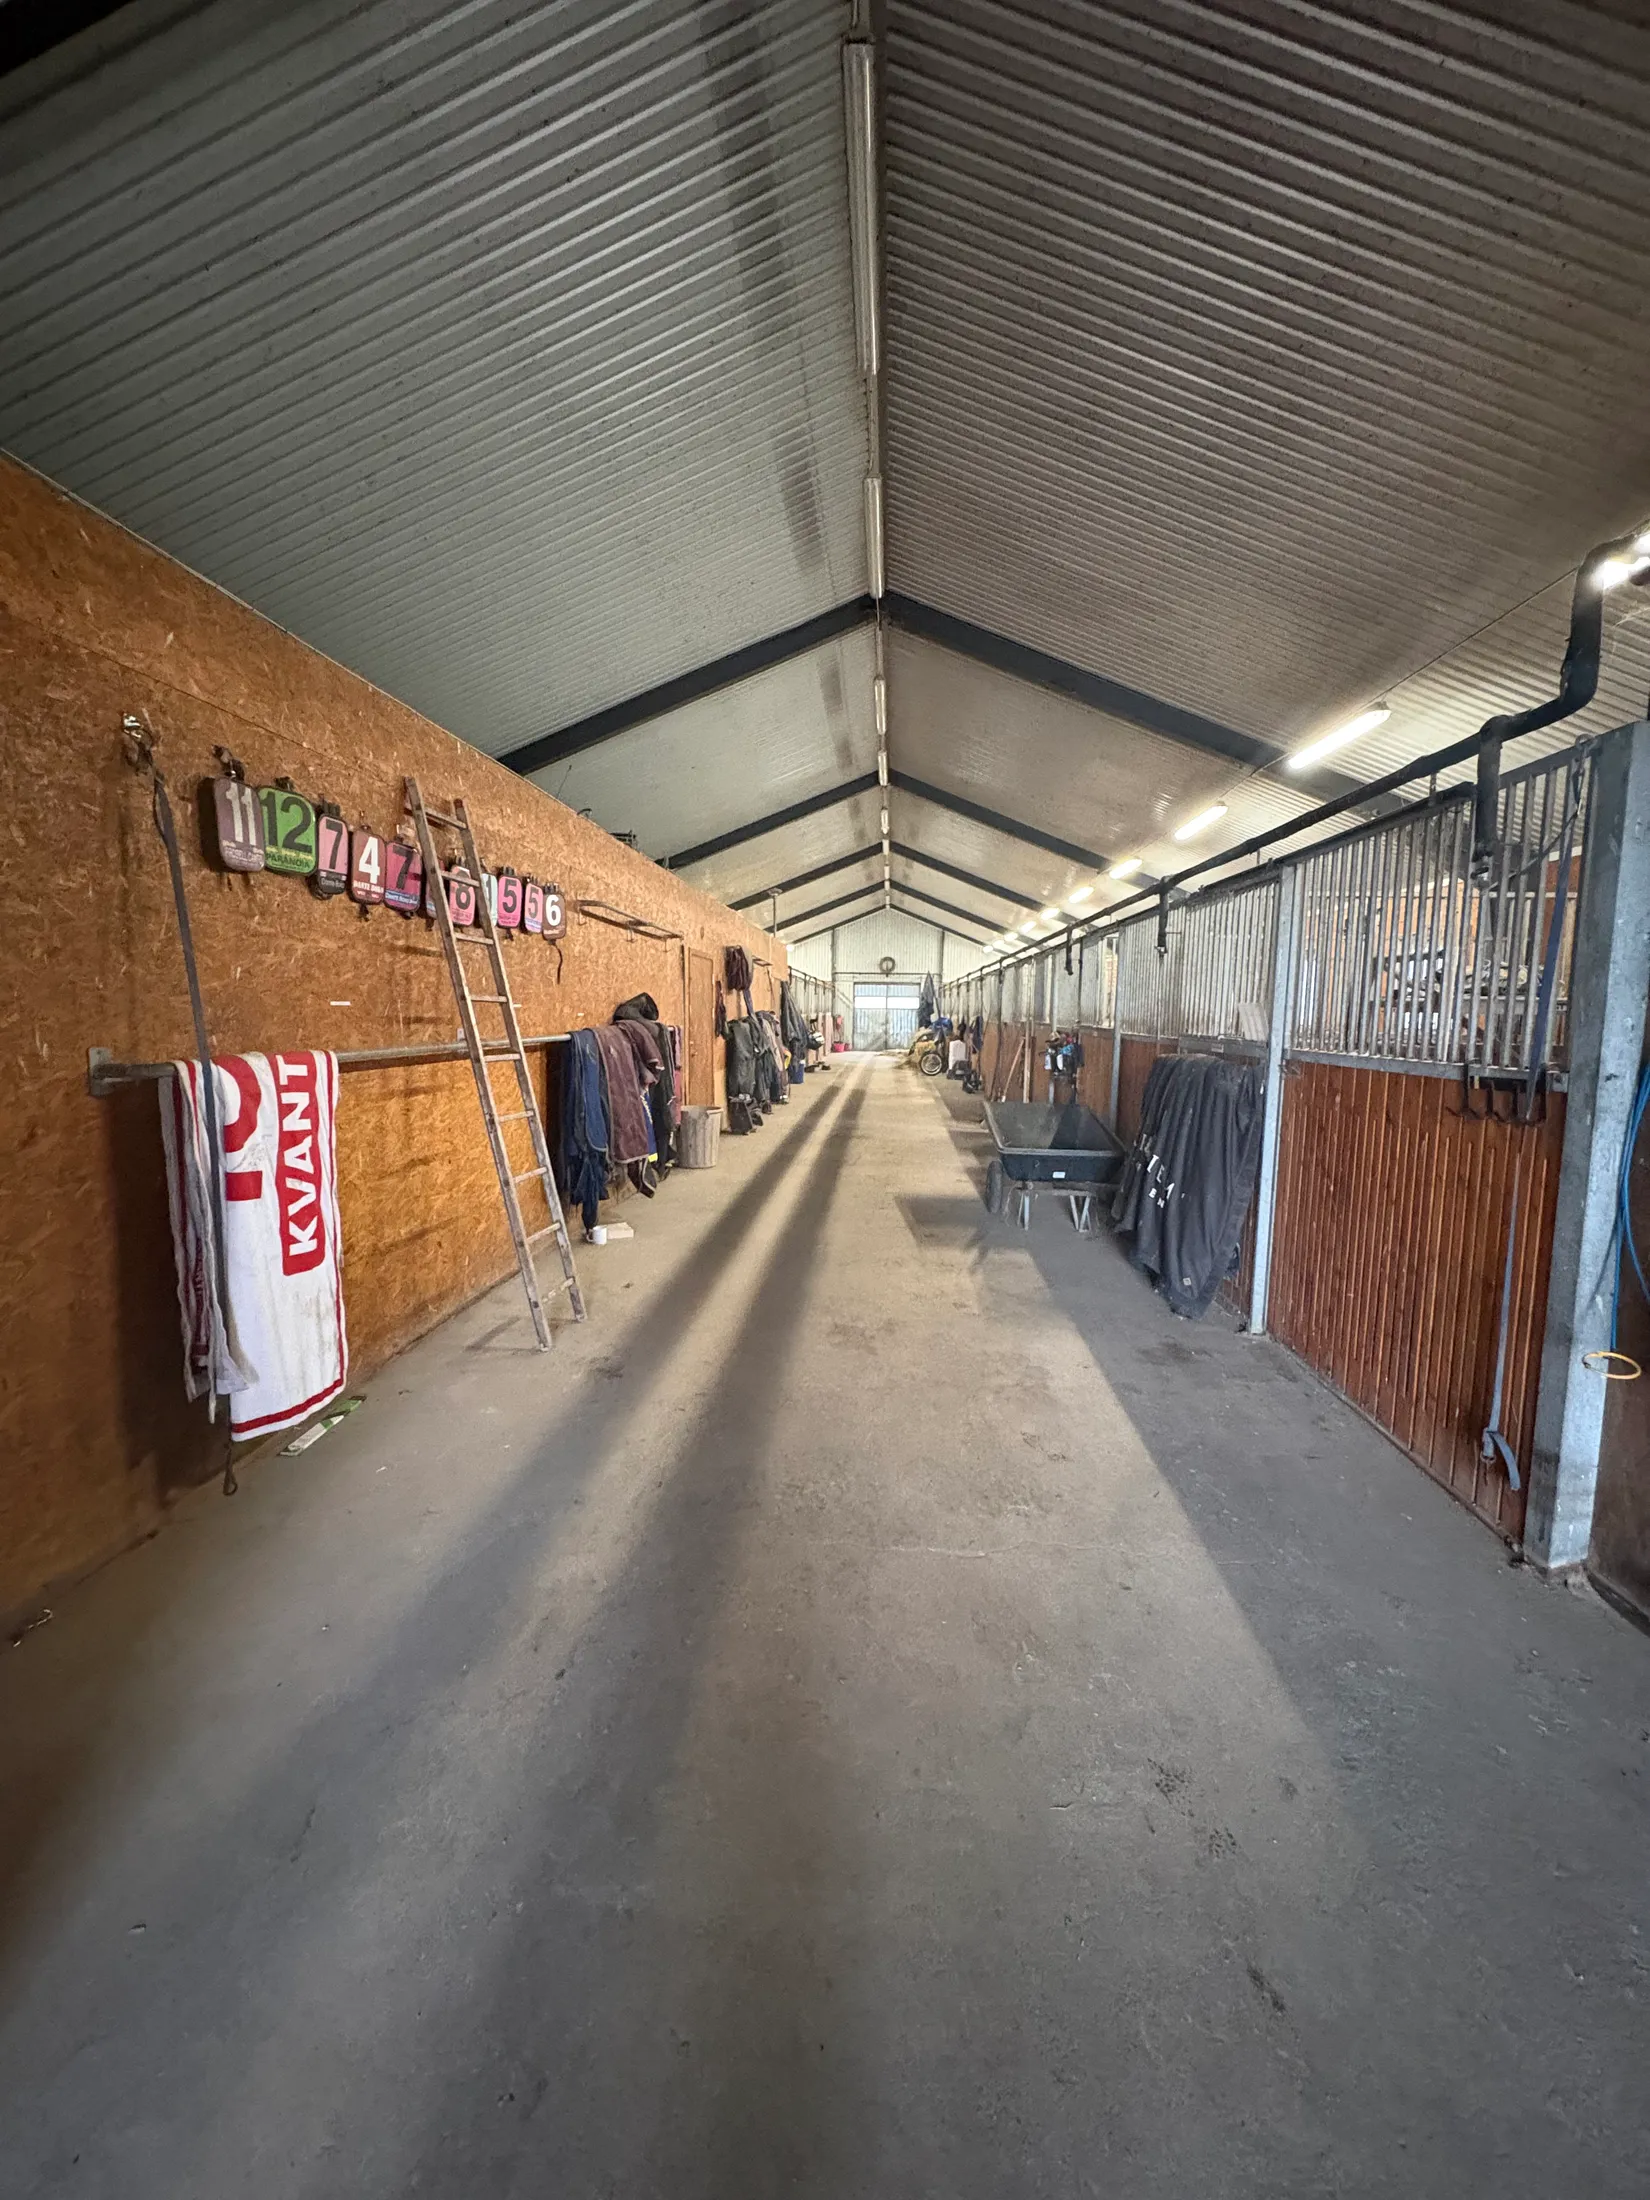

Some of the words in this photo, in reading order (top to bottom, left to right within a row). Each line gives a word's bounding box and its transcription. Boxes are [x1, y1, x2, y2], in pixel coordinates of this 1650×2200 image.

[225, 781, 257, 847] 11
[260, 790, 314, 854] 12
[325, 817, 344, 870] 7
[358, 835, 381, 885] 4
[392, 844, 414, 890] 7
[502, 878, 518, 913] 5
[527, 886, 539, 919] 5
[545, 894, 562, 927] 6
[276, 1054, 318, 1257] KVANT
